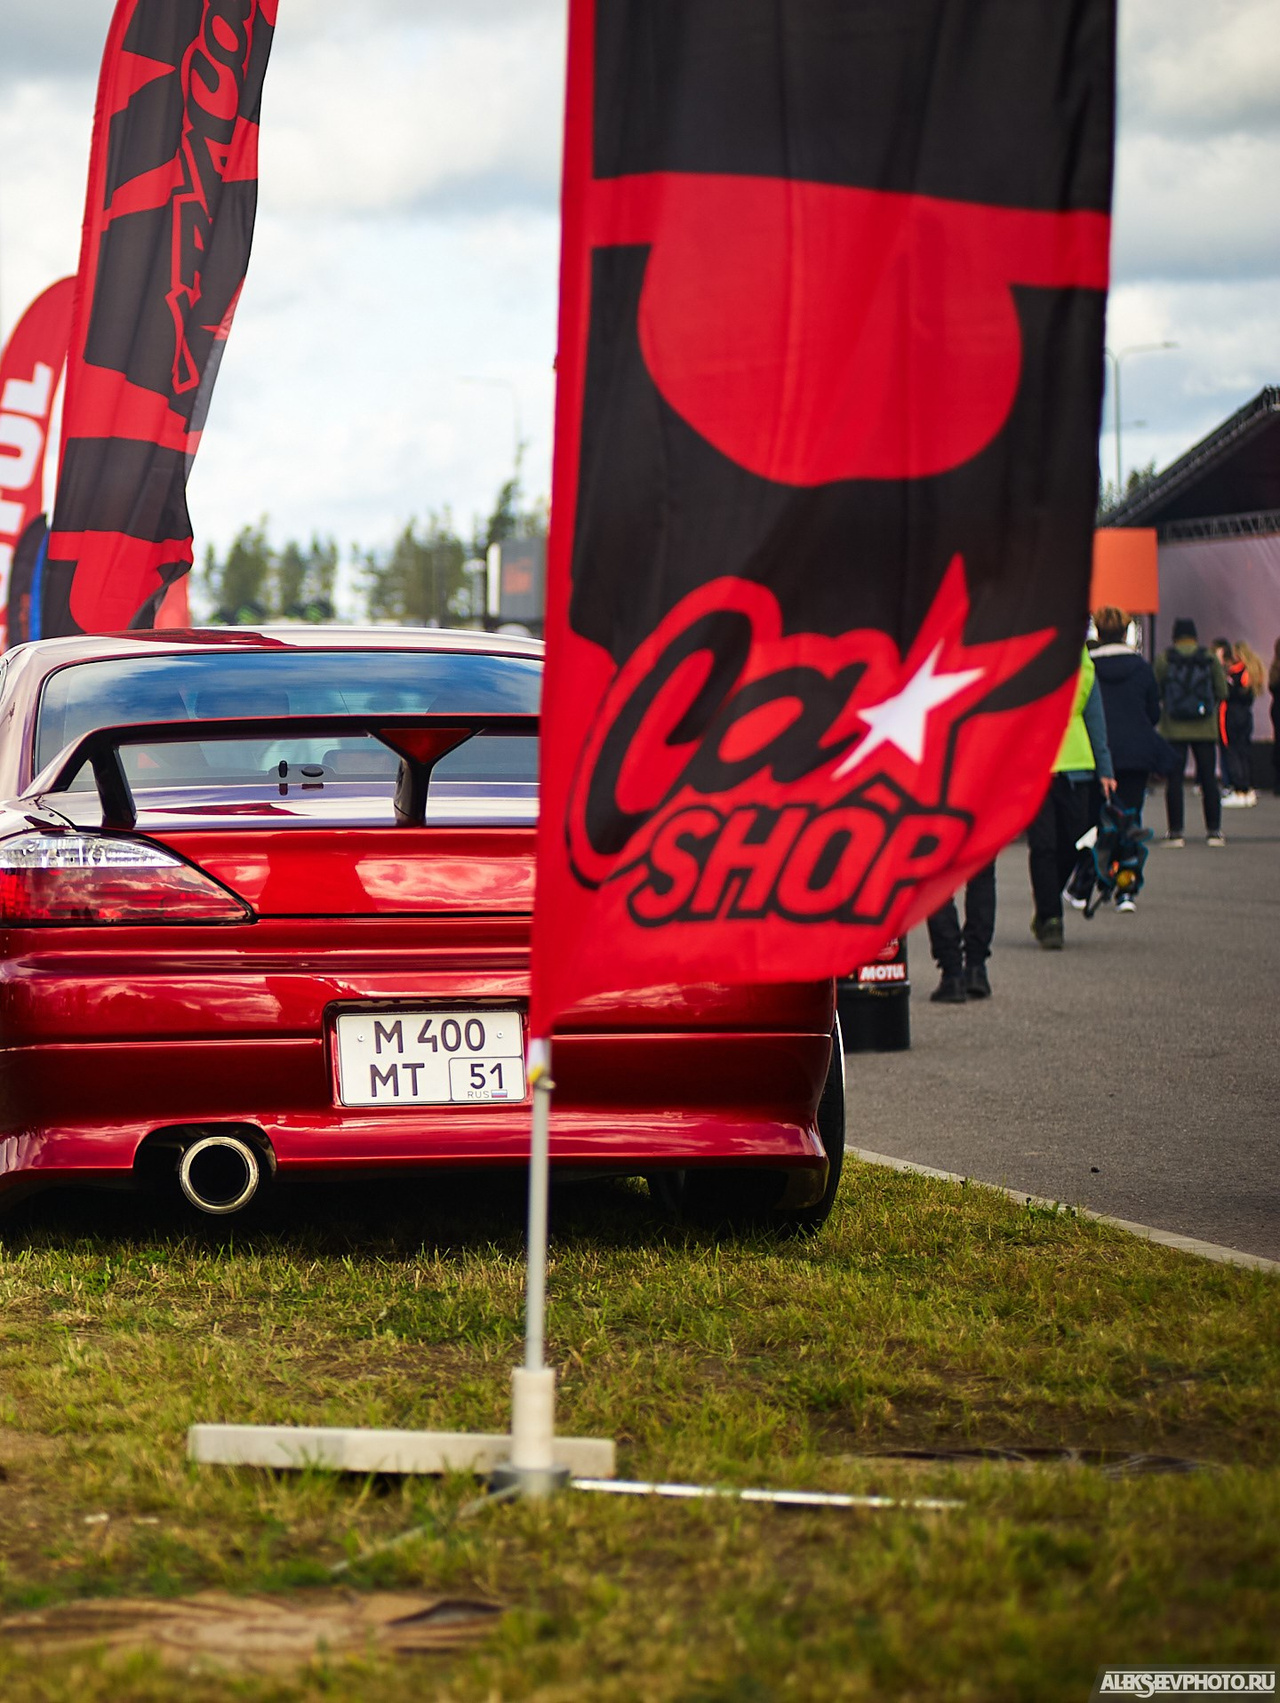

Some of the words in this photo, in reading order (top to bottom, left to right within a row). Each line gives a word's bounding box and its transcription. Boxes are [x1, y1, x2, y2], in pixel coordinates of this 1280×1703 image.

[627, 800, 974, 928] SHOP
[860, 964, 905, 981] MOTUL
[373, 1019, 404, 1055] M
[417, 1018, 486, 1053] 400
[369, 1062, 426, 1098] MT
[469, 1062, 503, 1090] 51
[467, 1089, 490, 1099] RUS
